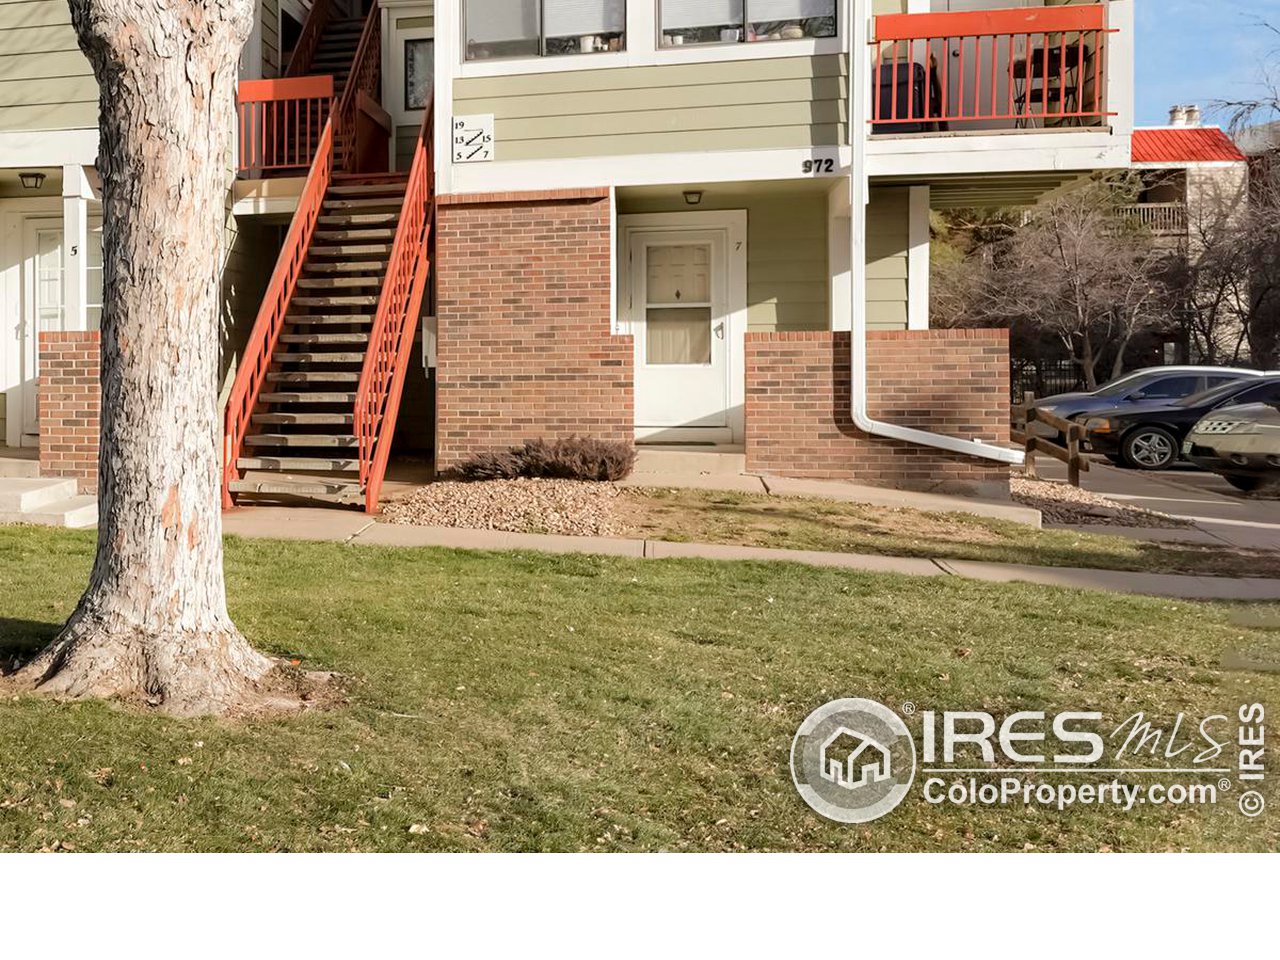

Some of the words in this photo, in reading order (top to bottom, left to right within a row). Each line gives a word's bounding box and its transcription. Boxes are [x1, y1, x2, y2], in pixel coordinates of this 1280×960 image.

[455, 121, 465, 130] 19
[455, 135, 465, 144] 13
[482, 134, 492, 143] 15
[456, 151, 462, 160] 5
[483, 150, 489, 158] 7
[802, 158, 834, 173] 972
[70, 245, 78, 256] 5
[735, 241, 742, 251] 7
